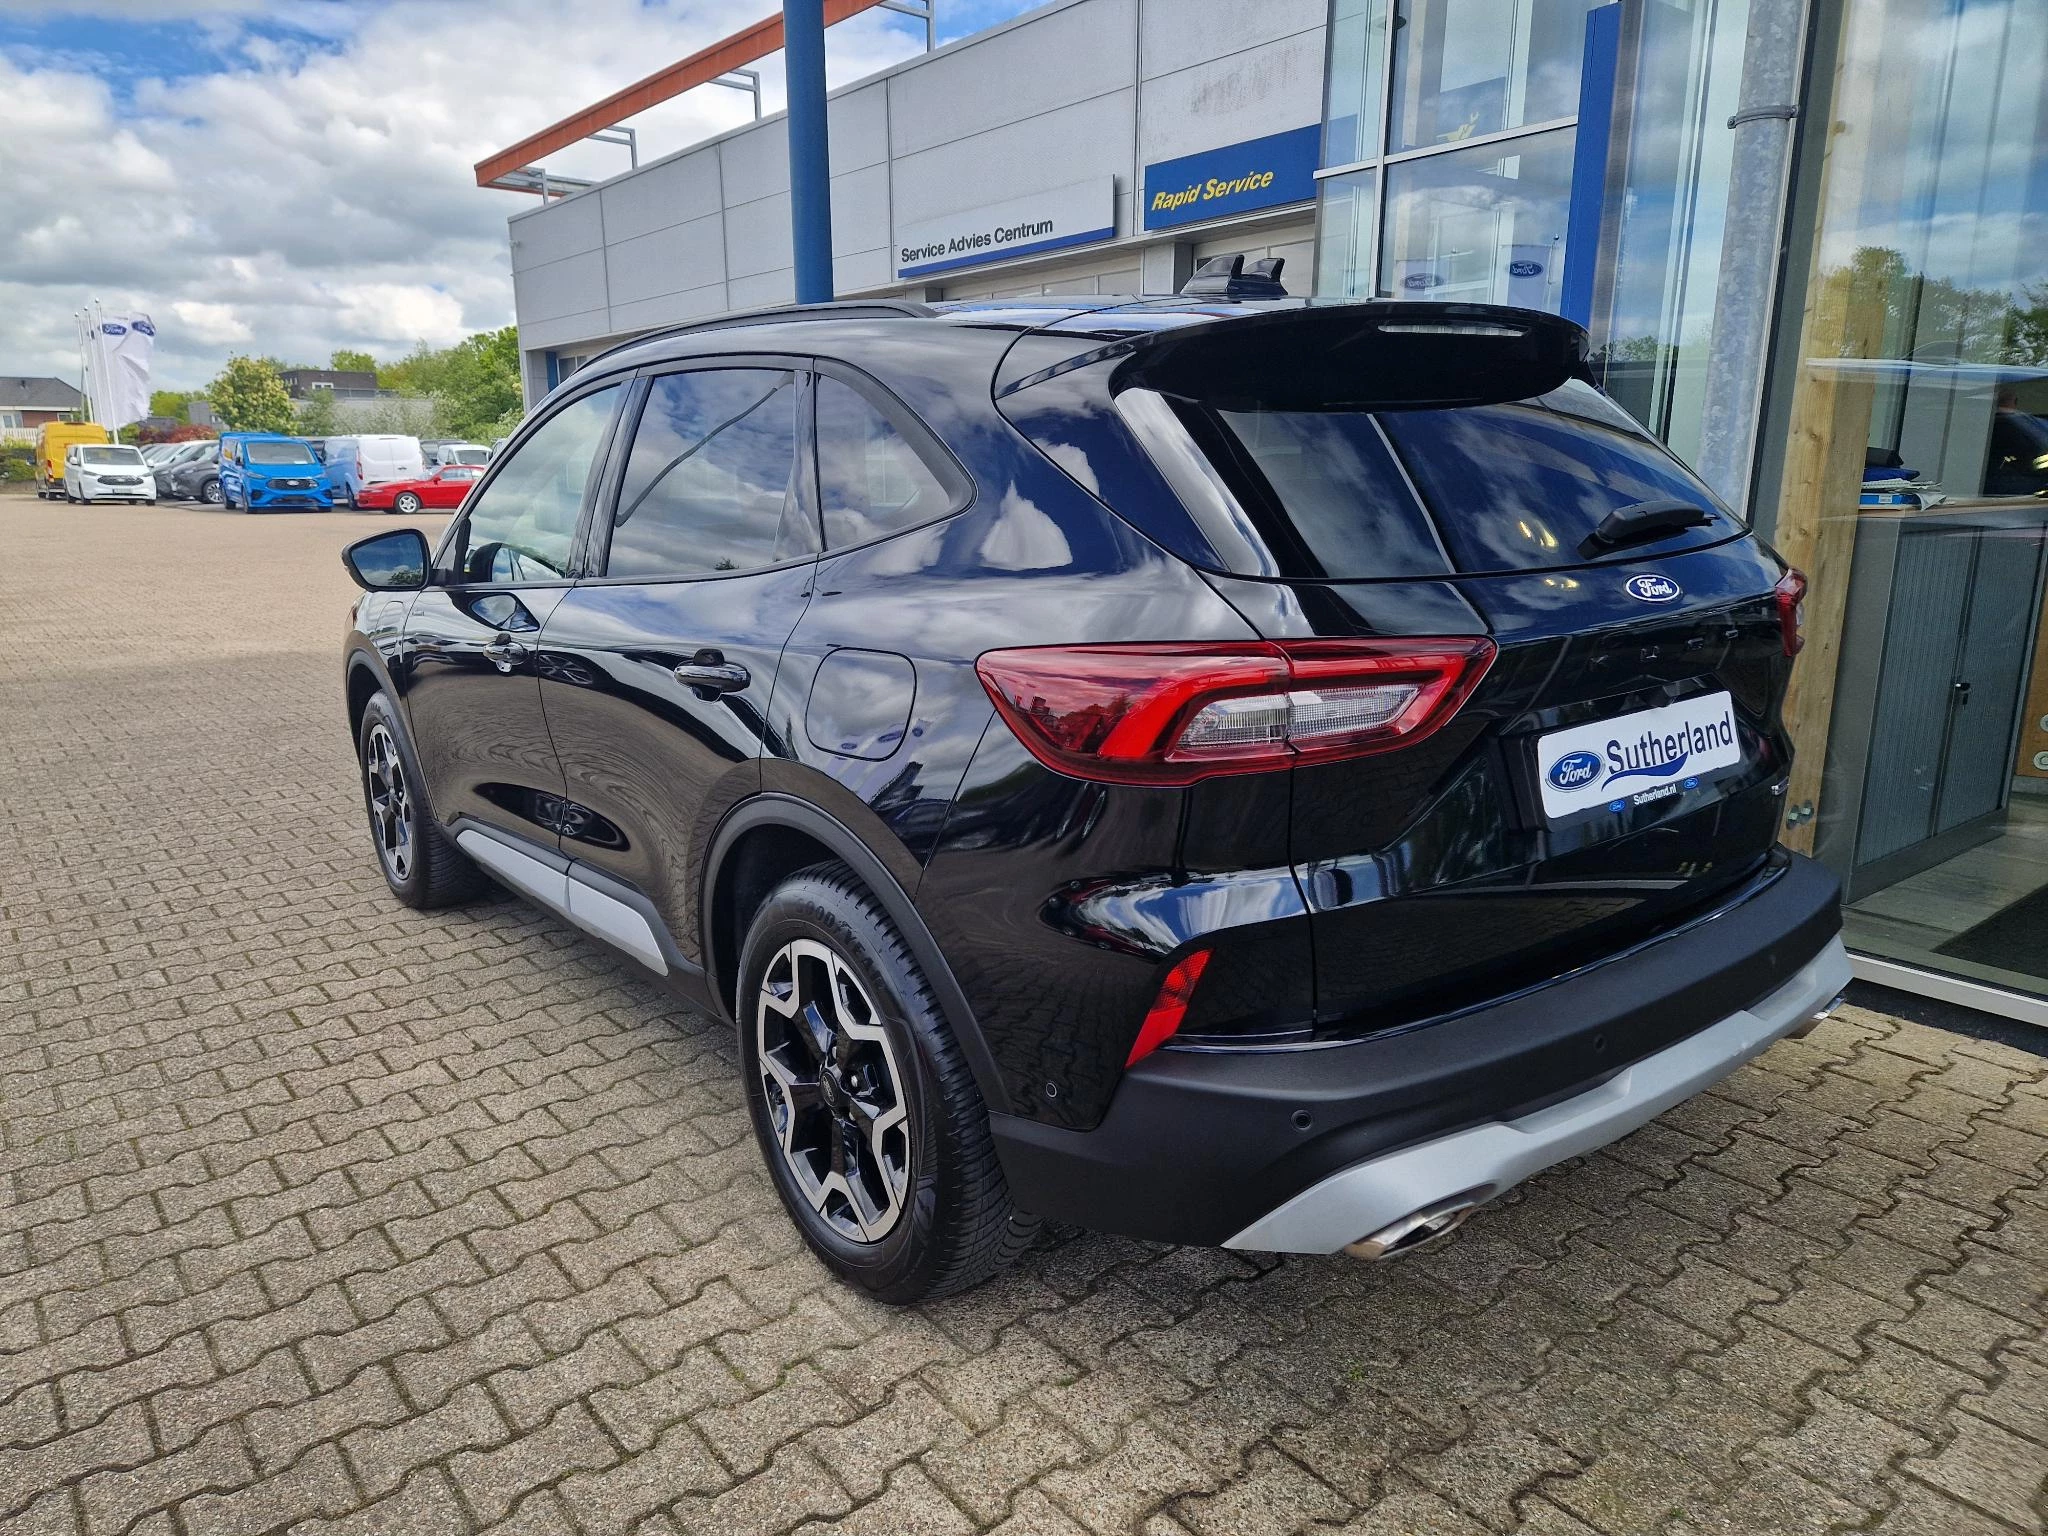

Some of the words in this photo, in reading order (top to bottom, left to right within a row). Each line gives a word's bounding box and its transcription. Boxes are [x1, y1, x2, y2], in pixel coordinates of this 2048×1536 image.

[1152, 184, 1202, 211] Rapid
[1203, 171, 1274, 200] Service
[901, 243, 945, 262] Service
[948, 233, 991, 253] Advies
[994, 220, 1053, 244] Centrum
[1637, 578, 1672, 597] Ford
[1559, 758, 1592, 784] Ford
[1606, 711, 1733, 775] Sutherland
[1633, 783, 1677, 805] Sutherland.nl
